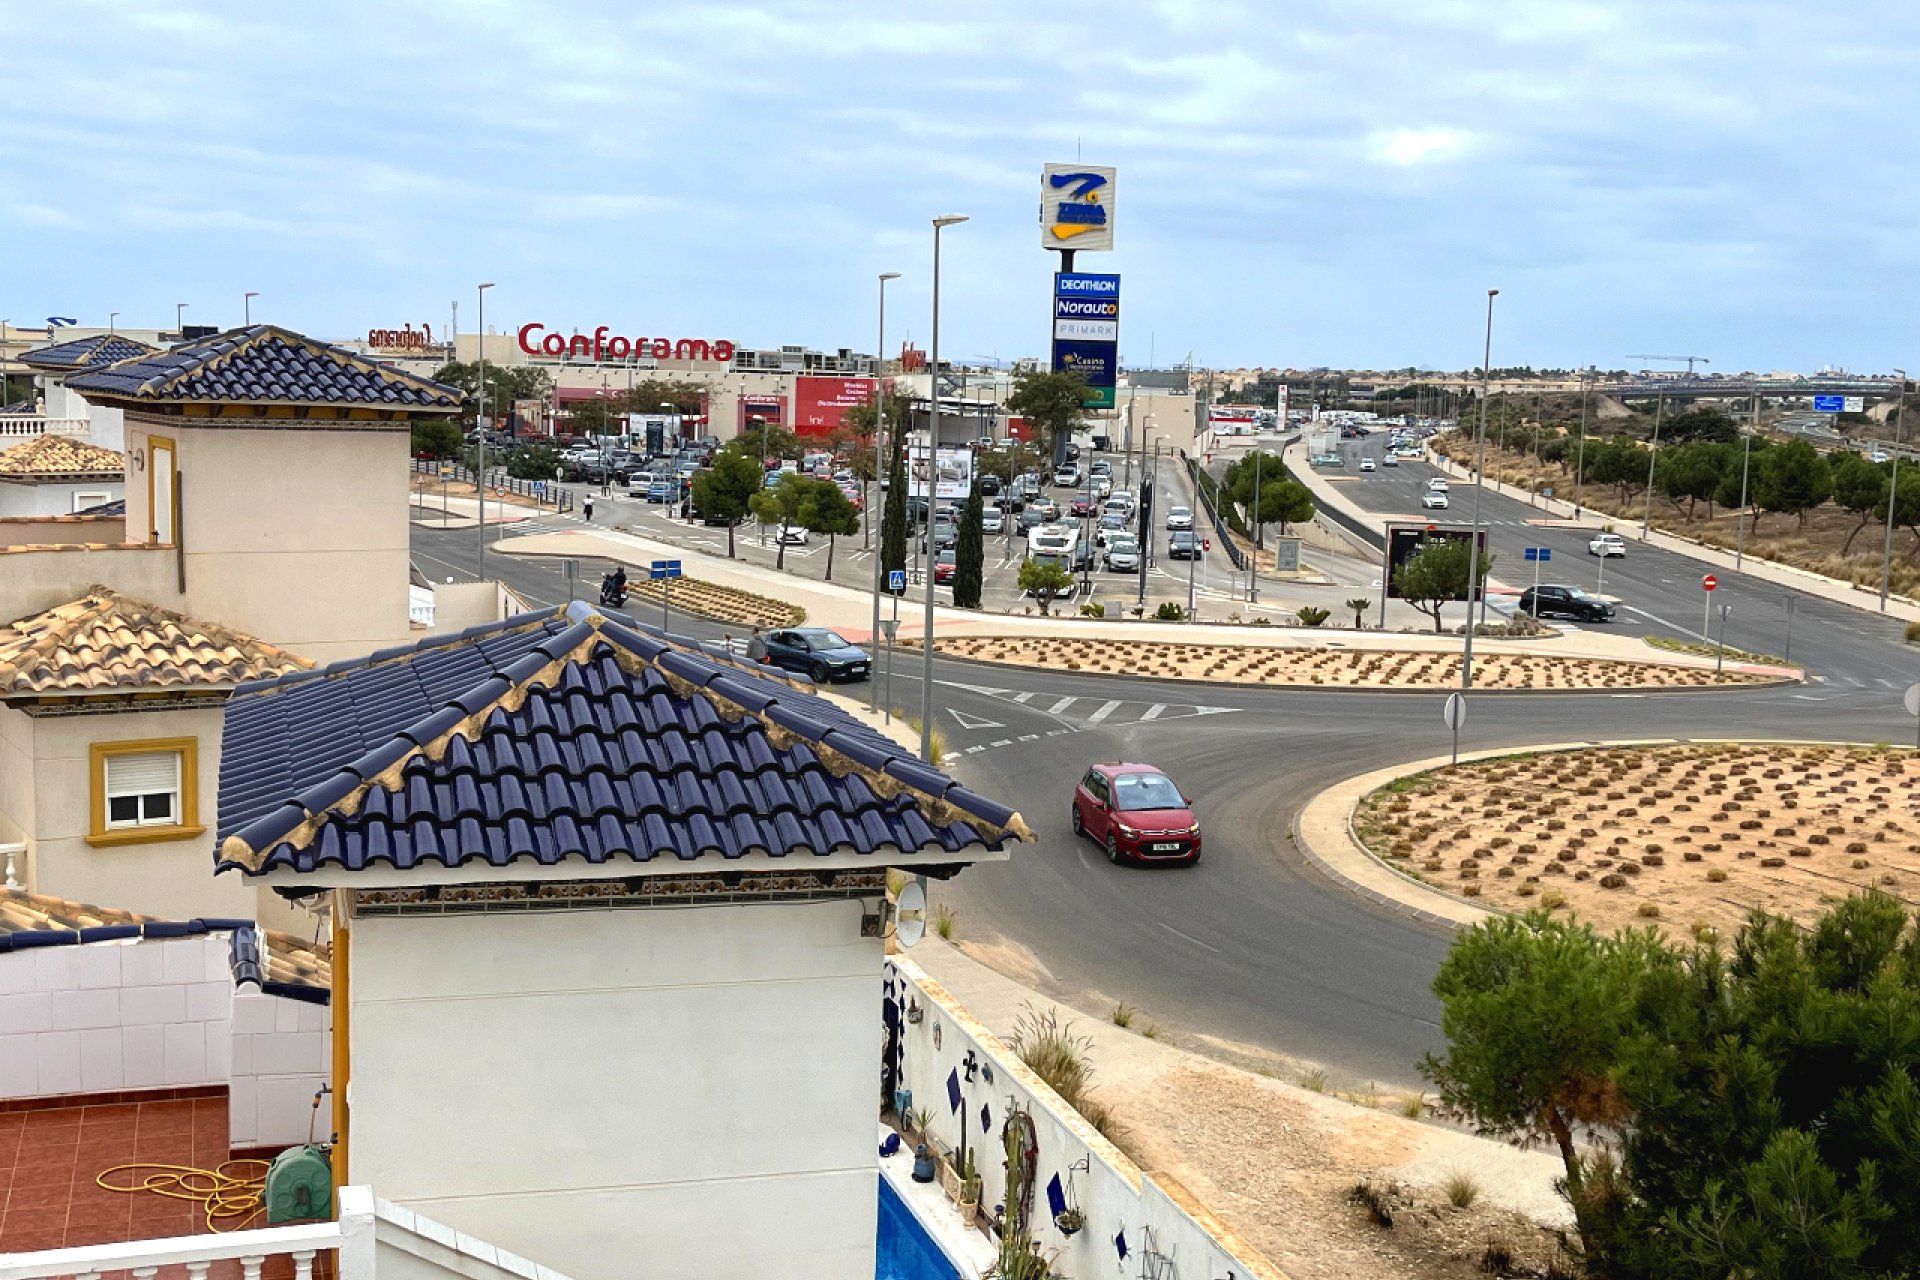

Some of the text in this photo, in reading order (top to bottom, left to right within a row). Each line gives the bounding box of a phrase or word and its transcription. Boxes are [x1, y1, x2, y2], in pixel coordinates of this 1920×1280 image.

[1061, 280, 1115, 291] DECATHLON
[1058, 301, 1117, 314] Norauto
[1060, 325, 1113, 335] PRIMARK
[518, 323, 733, 362] Conforama
